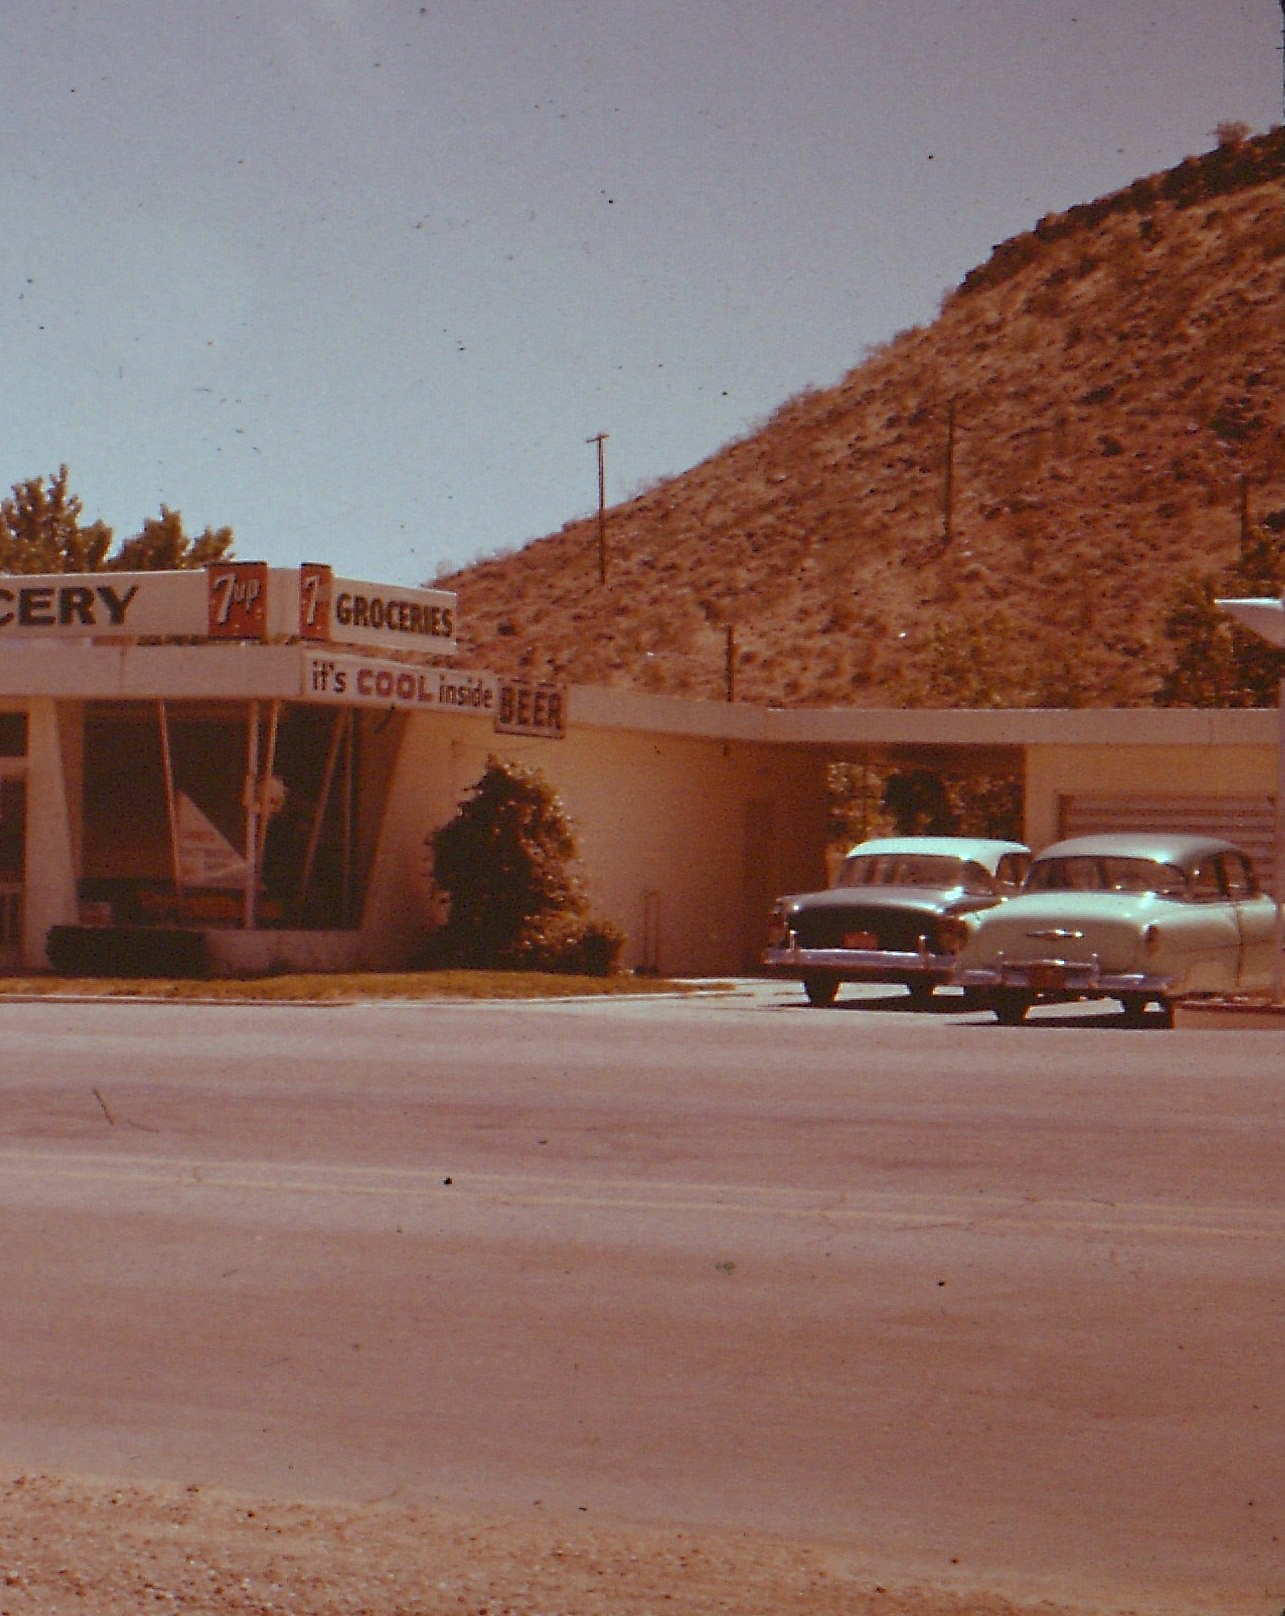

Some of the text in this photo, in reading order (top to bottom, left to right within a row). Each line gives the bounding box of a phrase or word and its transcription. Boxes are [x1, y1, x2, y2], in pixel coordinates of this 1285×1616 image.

[213, 574, 261, 626] 7up
[336, 592, 454, 638] GROCERIES
[312, 660, 493, 708] it's COOL inside
[499, 686, 561, 730] BEER
